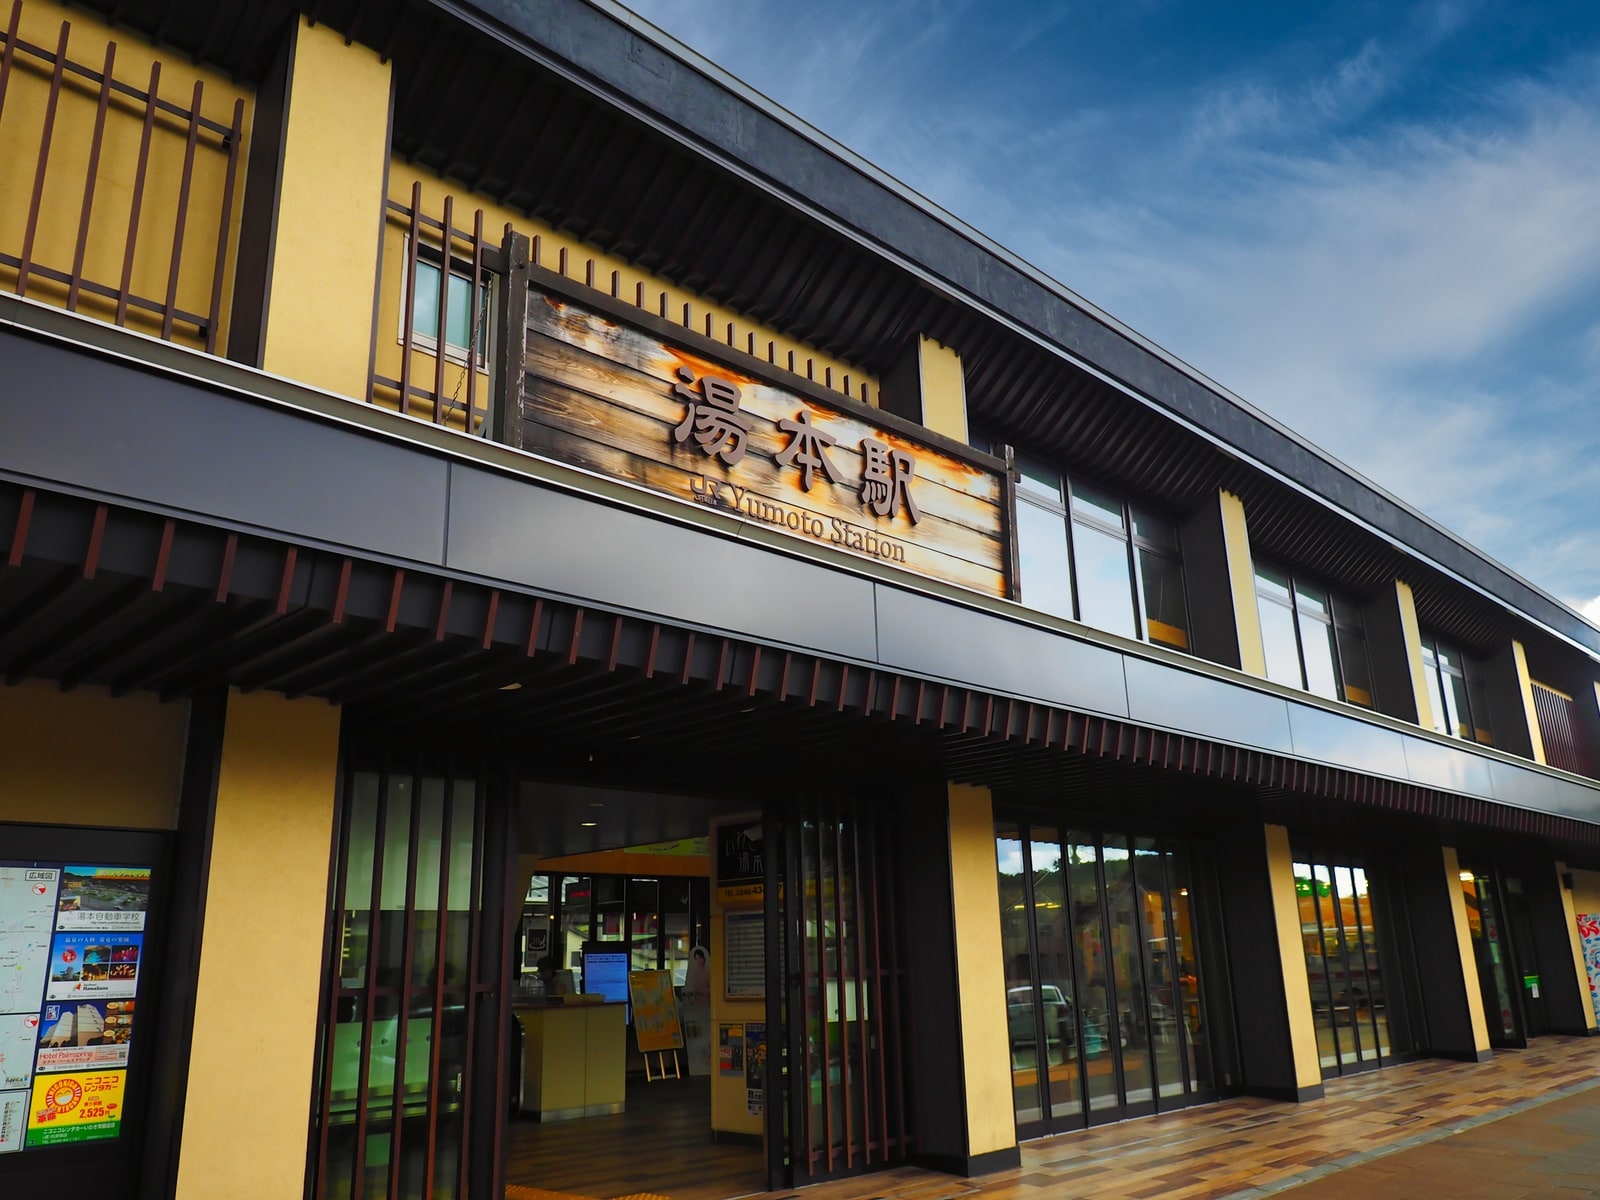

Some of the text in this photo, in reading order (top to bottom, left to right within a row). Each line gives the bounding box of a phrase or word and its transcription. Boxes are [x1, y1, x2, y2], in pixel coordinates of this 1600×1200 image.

[673, 365, 922, 527] 湯本駅
[690, 474, 906, 563] JR Yumoto Station
[28, 871, 53, 880] 広域図
[77, 912, 140, 921] 湯本自動車学校
[40, 1052, 58, 1060] Hotel
[84, 1076, 119, 1085] ニコニコ
